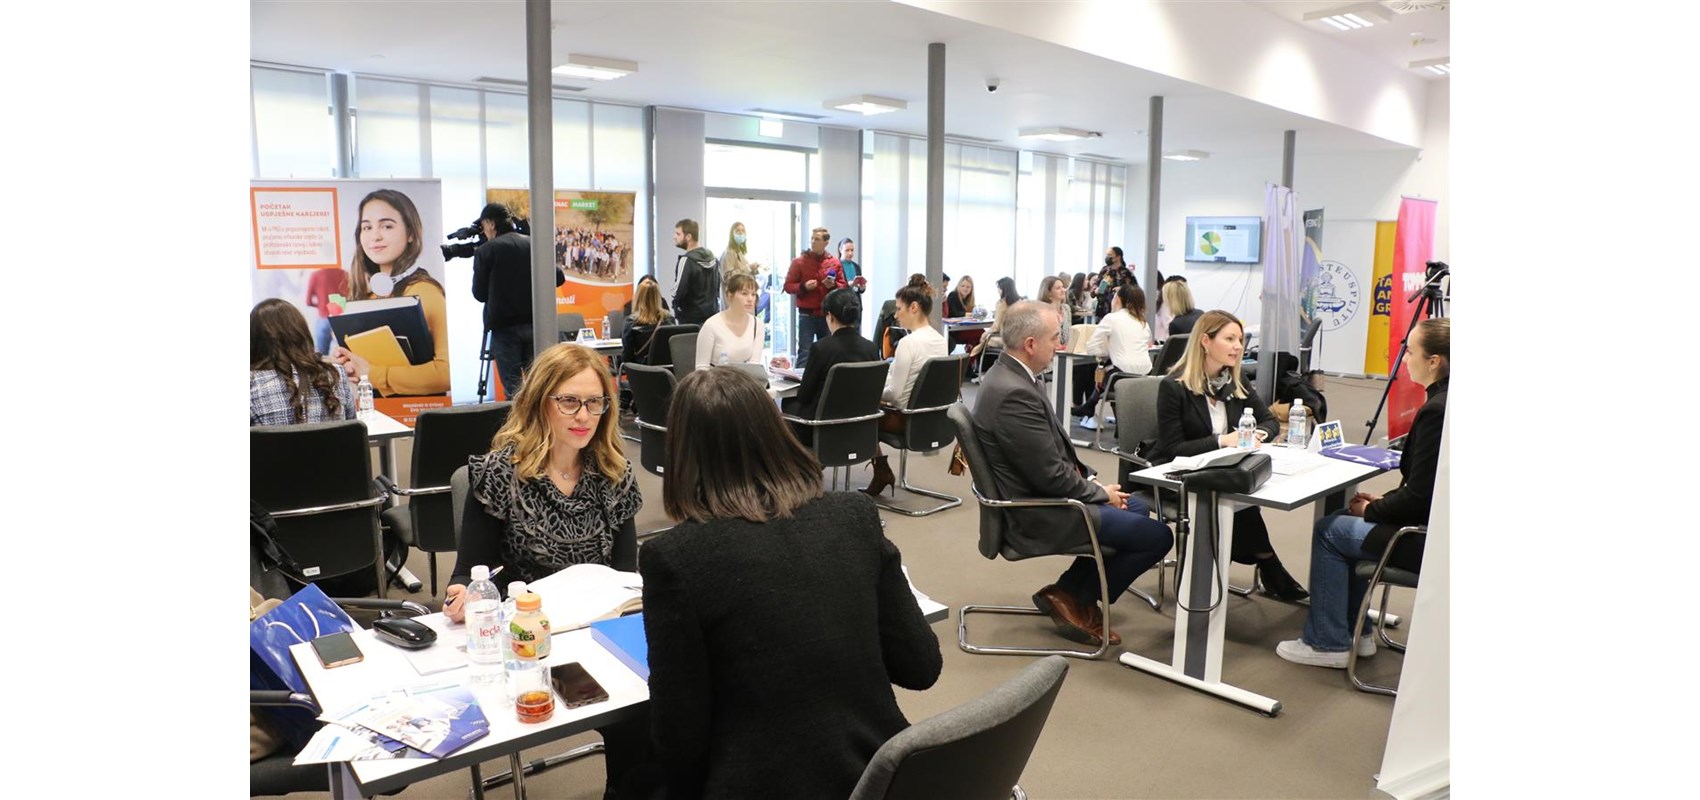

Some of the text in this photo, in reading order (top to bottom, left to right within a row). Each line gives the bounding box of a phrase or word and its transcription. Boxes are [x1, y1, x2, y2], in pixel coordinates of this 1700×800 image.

[1378, 277, 1392, 287] TA
[556, 294, 576, 304] nosti
[1376, 303, 1391, 313] GR
